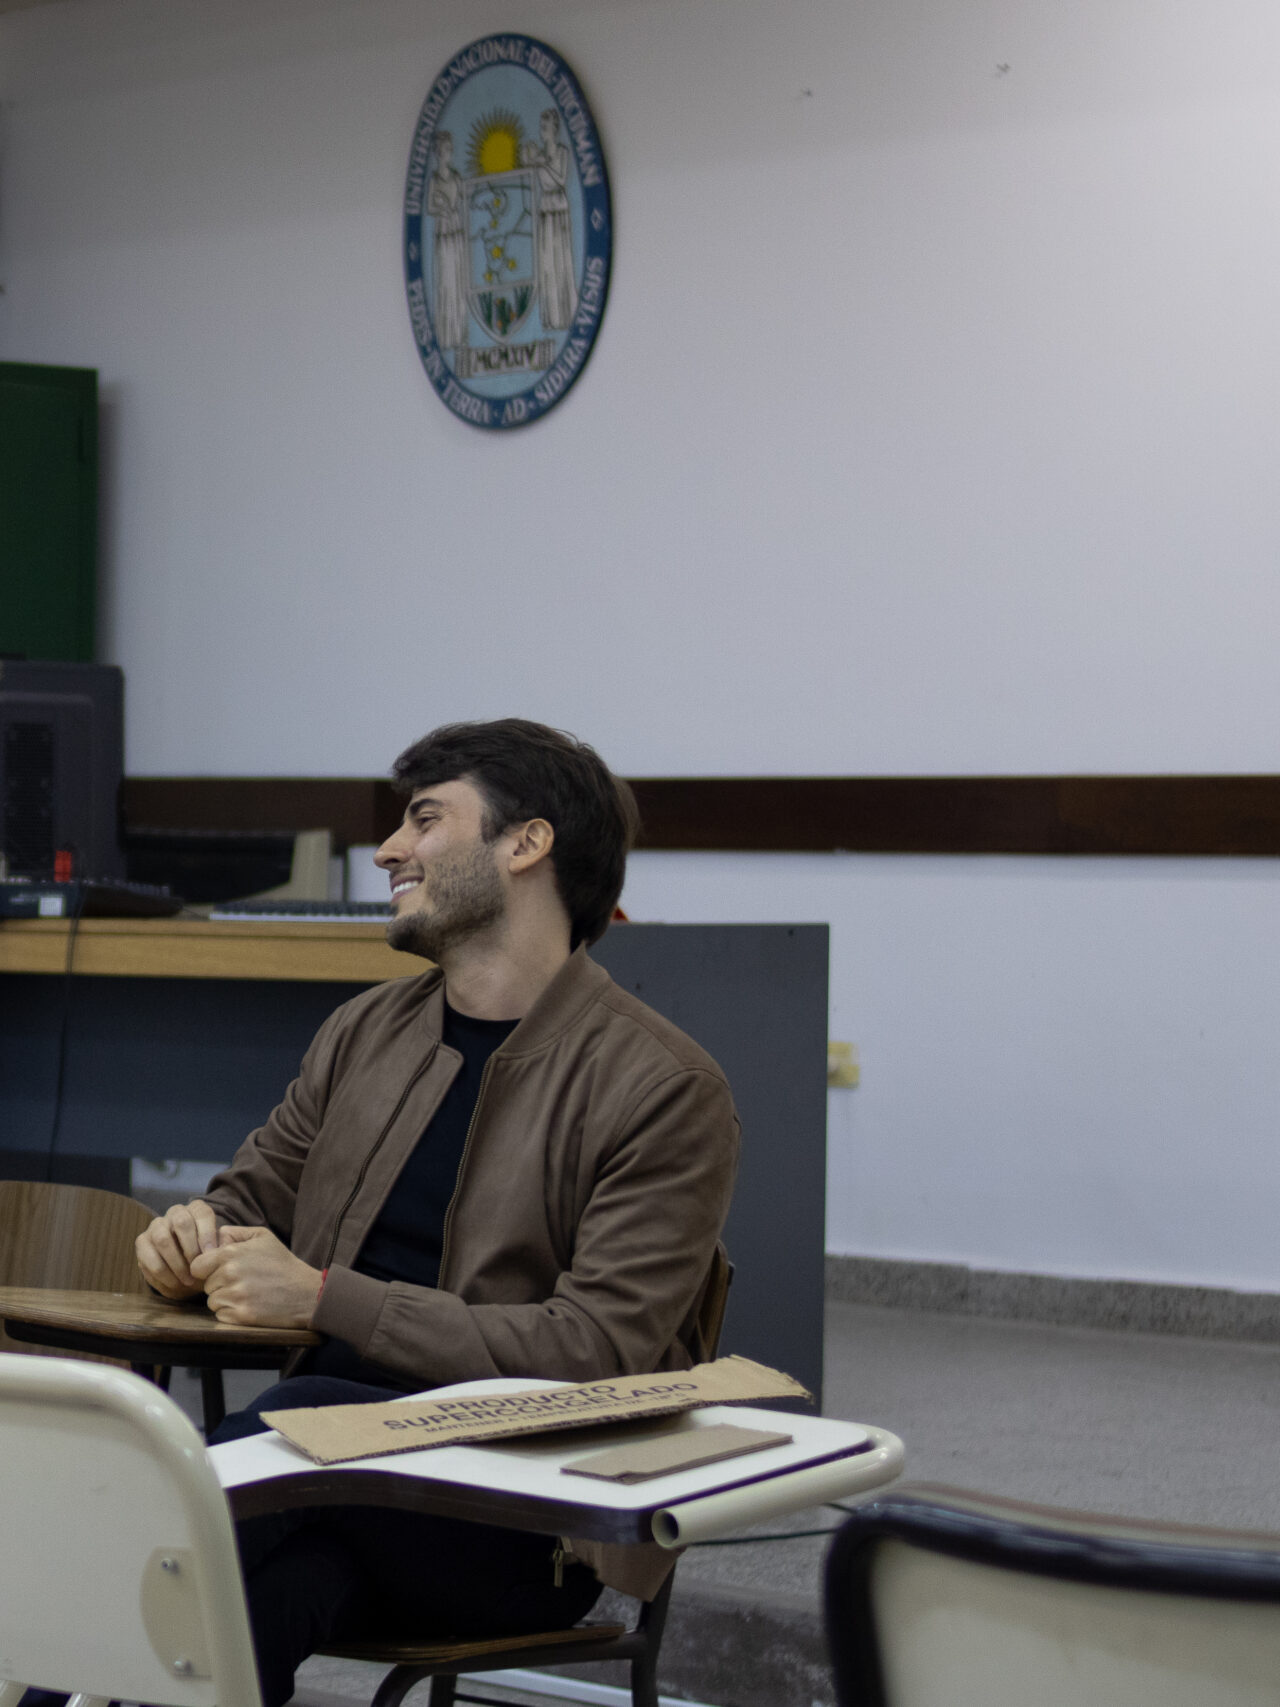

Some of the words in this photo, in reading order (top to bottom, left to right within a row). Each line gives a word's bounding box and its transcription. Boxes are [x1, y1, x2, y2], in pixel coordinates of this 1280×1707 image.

[406, 77, 451, 215] UNIVERSIDAD
[449, 38, 524, 84] NACIONAL
[383, 1383, 698, 1430] SUPERCONGELADO
[434, 1385, 616, 1413] PRODUCTO
[425, 1418, 505, 1433] MANTENER
